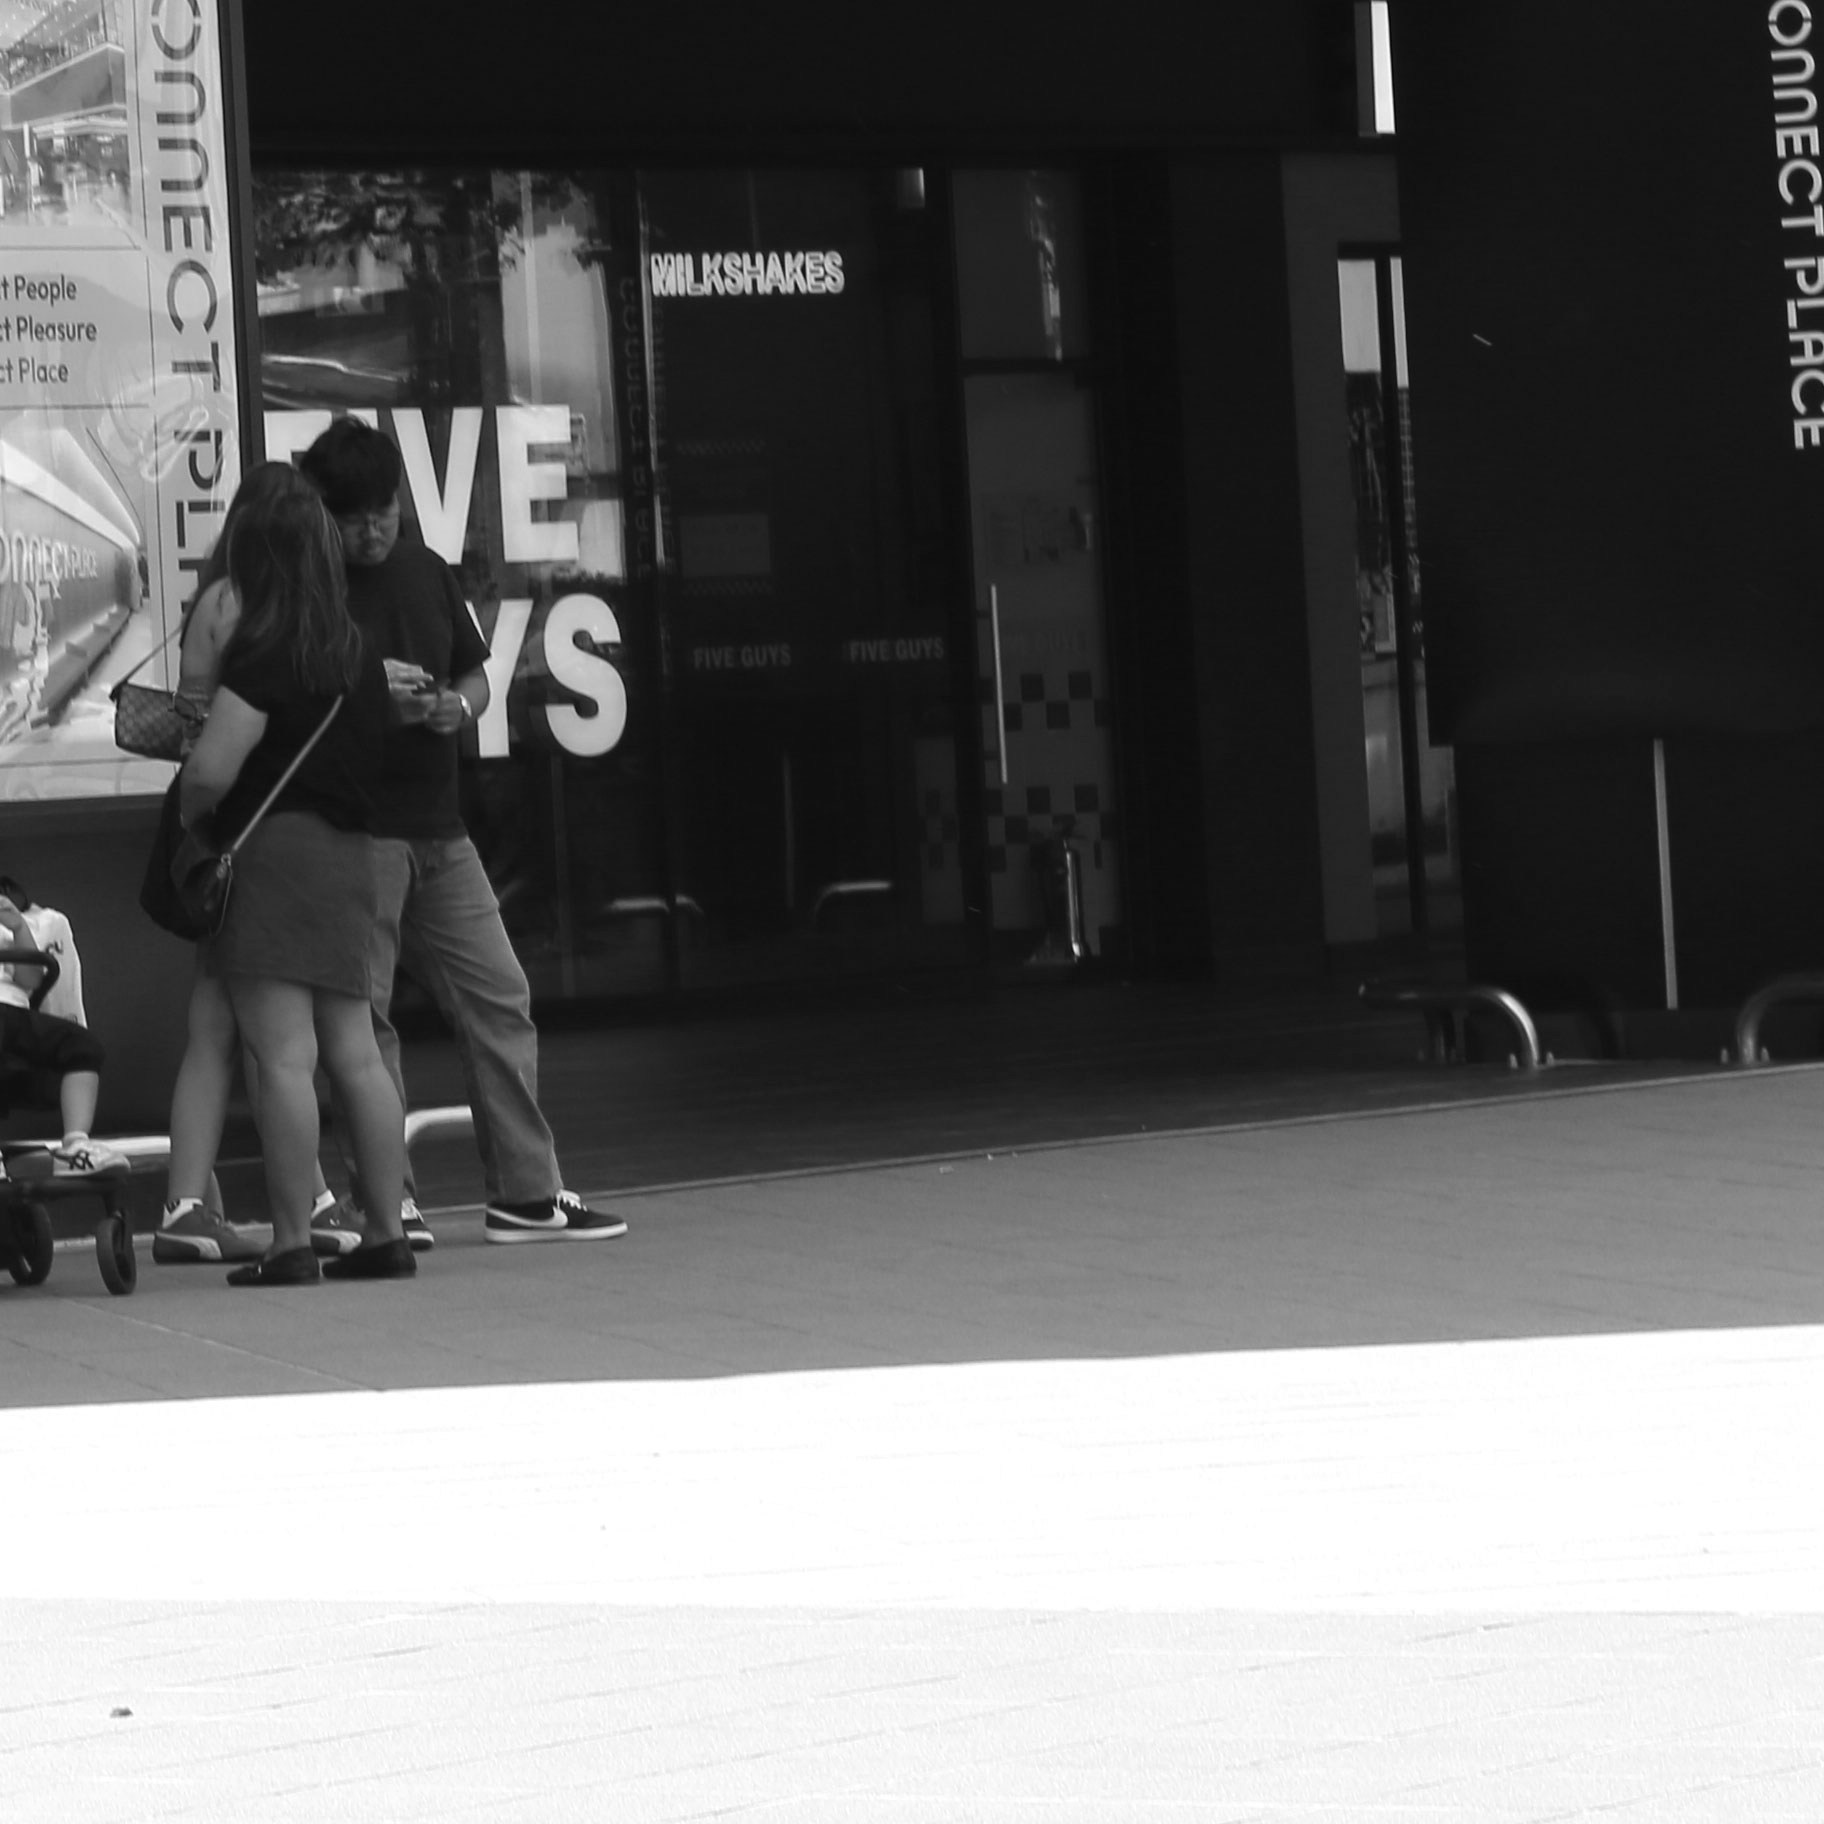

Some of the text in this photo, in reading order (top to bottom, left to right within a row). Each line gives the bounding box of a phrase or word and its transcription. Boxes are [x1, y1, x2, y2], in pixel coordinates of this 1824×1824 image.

[650, 250, 846, 298] MILKSHAKES
[14, 275, 78, 308] People
[16, 317, 98, 344] Pleasure
[1783, 256, 1824, 450] PLACE
[18, 358, 69, 385] Place
[692, 642, 792, 671] FIVE GUYS
[849, 636, 945, 664] FIVE GUYS
